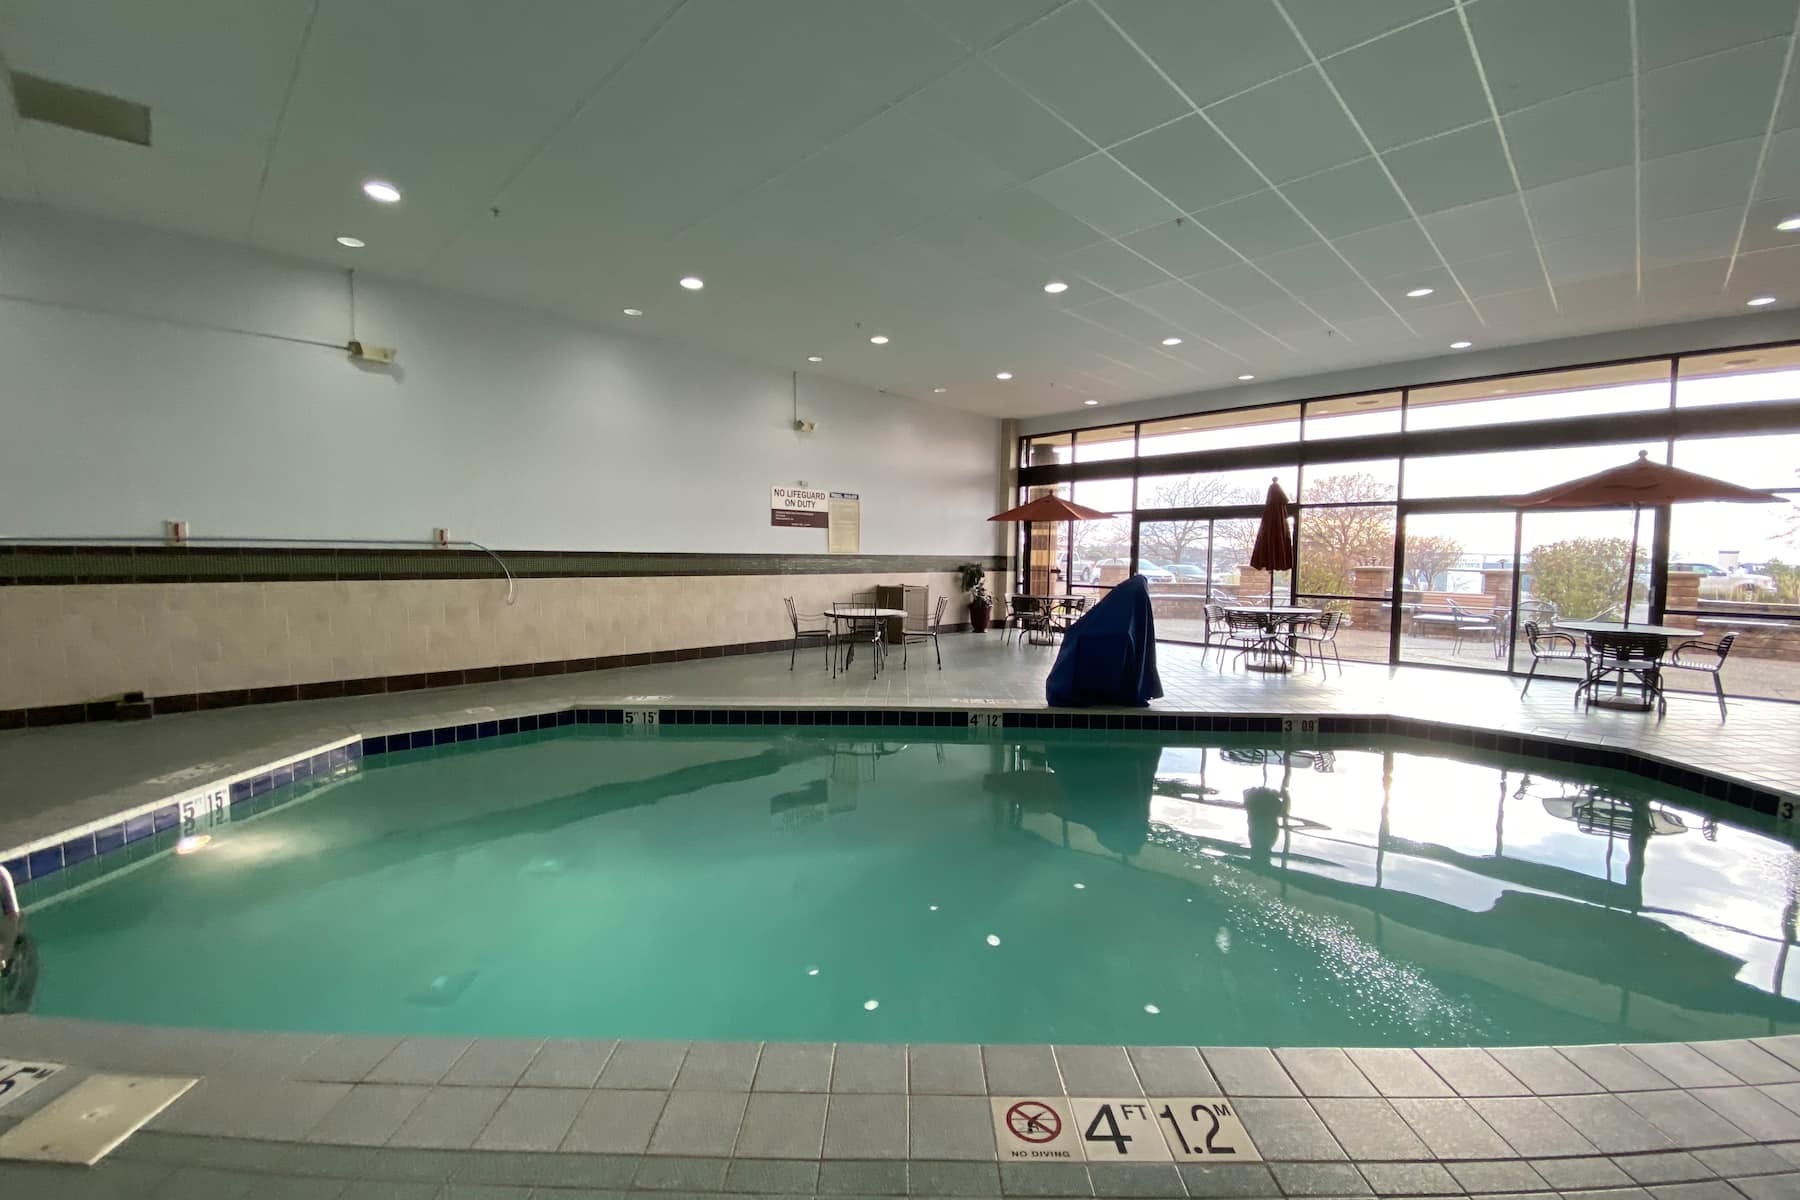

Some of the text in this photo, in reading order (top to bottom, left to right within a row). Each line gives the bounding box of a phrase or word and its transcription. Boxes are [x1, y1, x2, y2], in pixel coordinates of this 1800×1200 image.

[774, 488, 785, 497] NO
[787, 490, 825, 500] LIFEGUARD
[784, 498, 816, 508] ON DUTY
